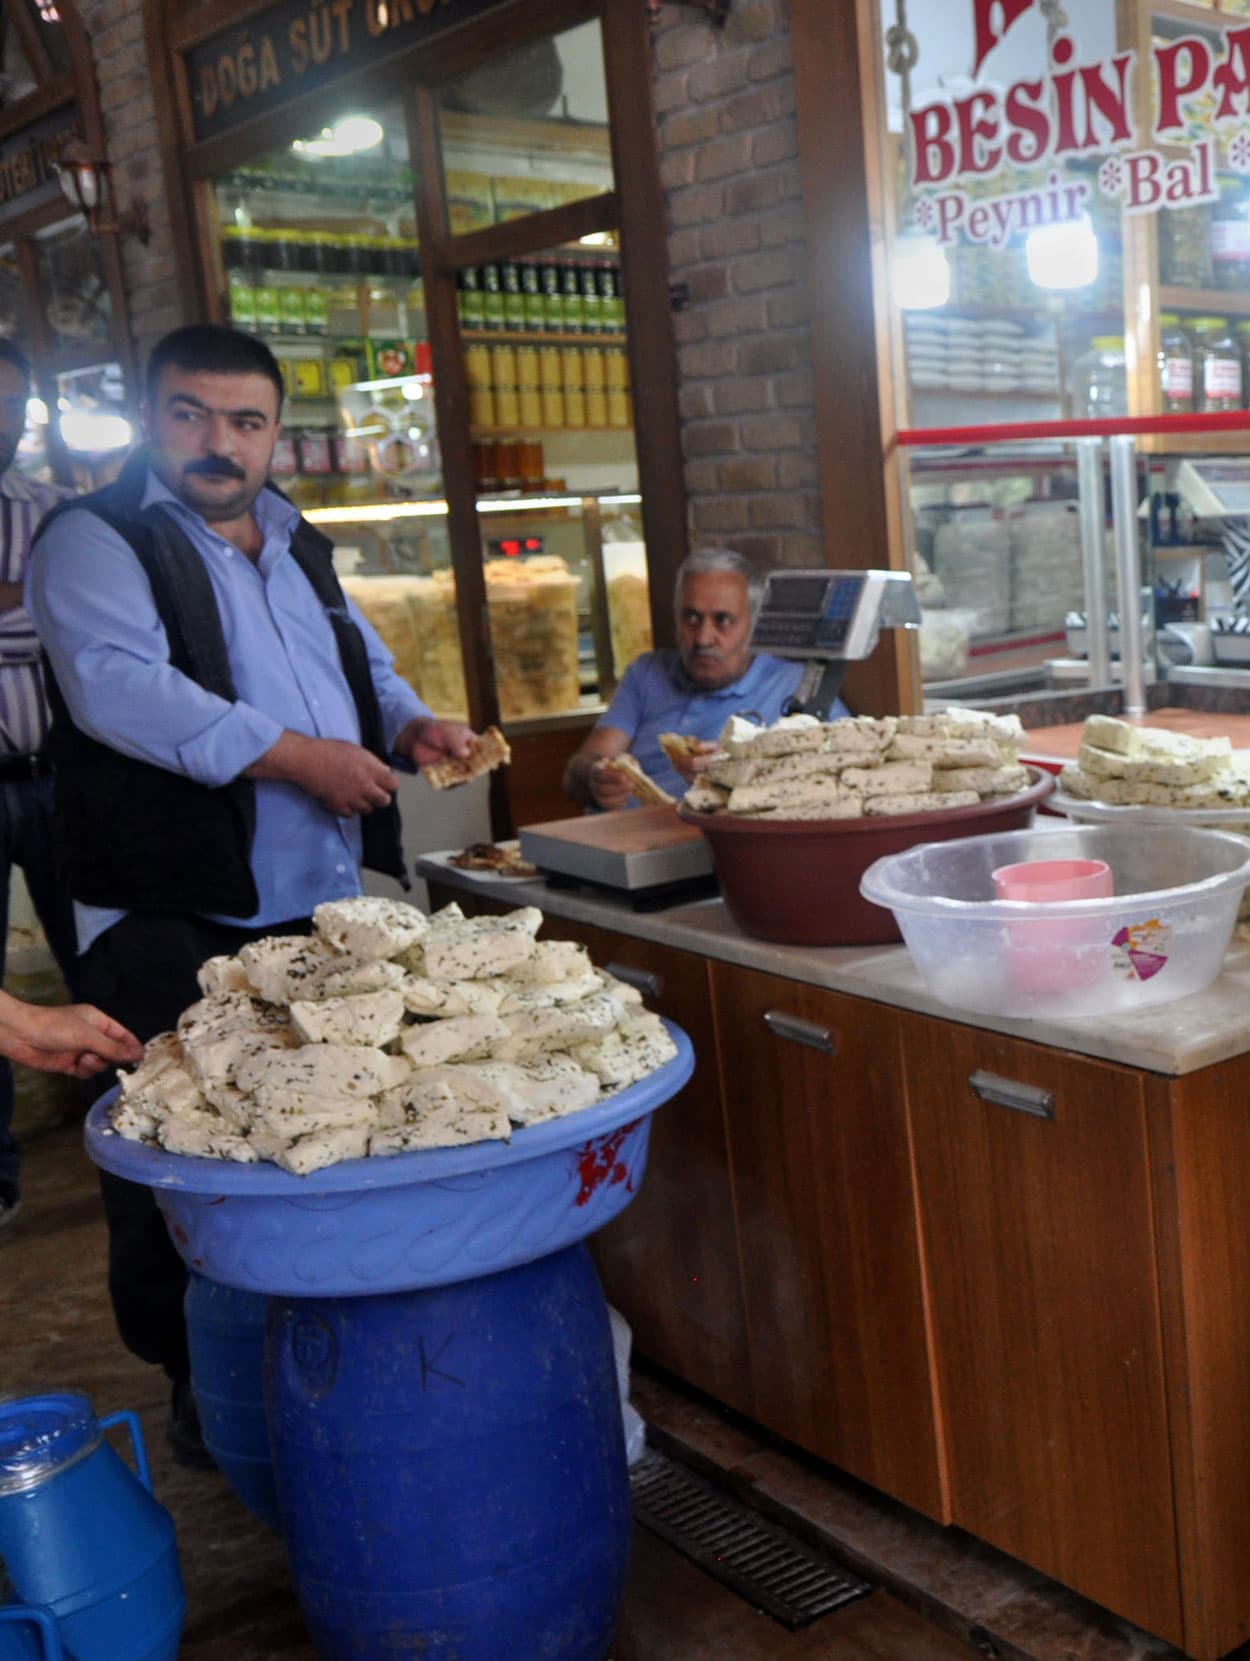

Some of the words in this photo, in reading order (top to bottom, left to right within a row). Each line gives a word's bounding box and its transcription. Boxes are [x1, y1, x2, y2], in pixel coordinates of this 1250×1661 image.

[197, 31, 282, 118] DOĞA
[910, 37, 1132, 185] BESİN
[935, 174, 1087, 246] Peynir
[1124, 143, 1214, 208] Bal
